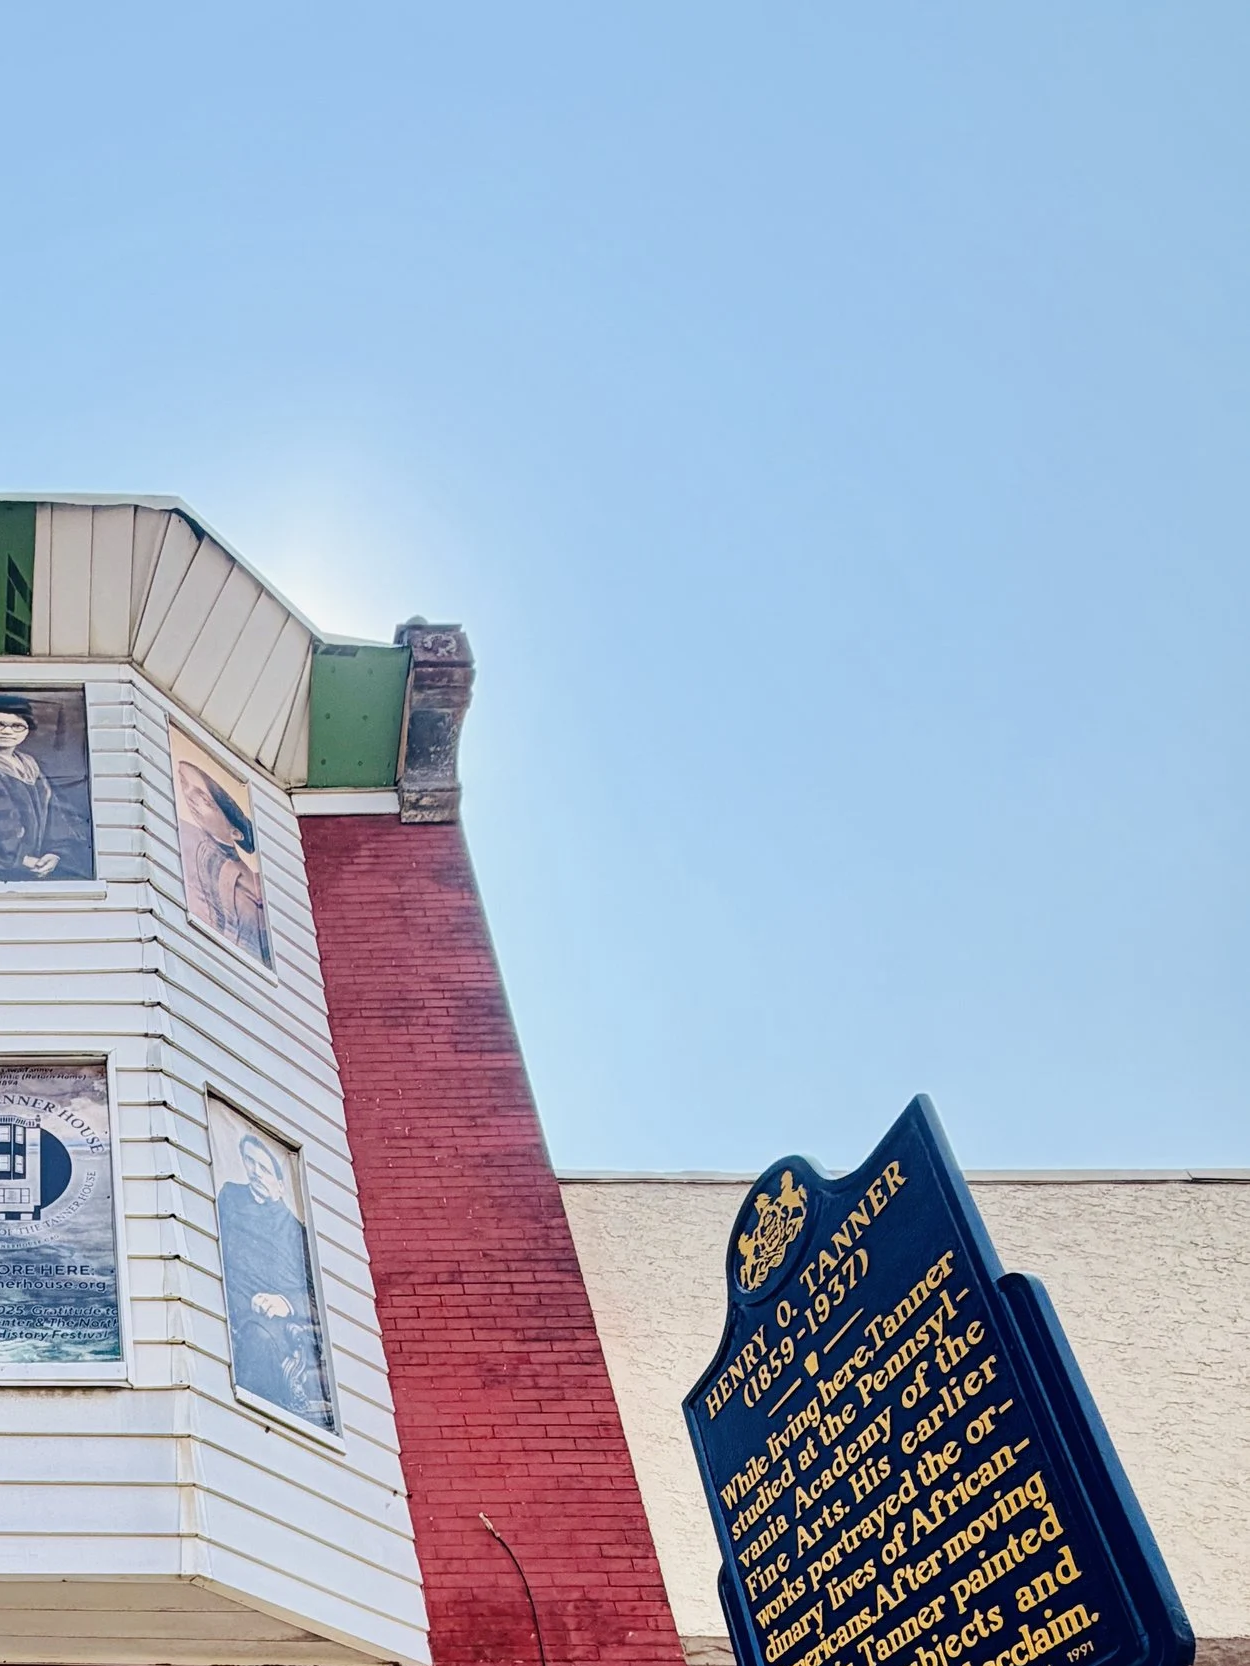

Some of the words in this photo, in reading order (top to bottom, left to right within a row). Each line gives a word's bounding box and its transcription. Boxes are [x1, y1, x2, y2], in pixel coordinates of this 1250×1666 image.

[57, 1109, 104, 1155] HOUSE
[19, 1223, 42, 1235] THE
[43, 1200, 84, 1229] TANNER
[79, 1171, 98, 1202] HOUSE
[31, 1305, 102, 1316] Gratitude
[35, 1317, 46, 1328] &
[50, 1317, 75, 1328] The
[40, 1264, 96, 1276] HERE:
[705, 1325, 768, 1420] HENRY
[776, 1300, 798, 1328] O.
[800, 1160, 908, 1297] TANNER
[52, 1330, 111, 1340] Festival
[720, 1455, 769, 1511] While
[766, 1396, 821, 1463] living
[864, 1250, 956, 1352] Tanner
[730, 1459, 796, 1542] studied
[797, 1436, 819, 1472] at
[819, 1400, 857, 1447] the
[854, 1287, 970, 1408] Pennsyl-
[738, 1511, 789, 1569] vania
[794, 1405, 893, 1519] Academy
[901, 1361, 929, 1409] of
[934, 1319, 986, 1373] the
[745, 1551, 790, 1602] Fine
[796, 1498, 851, 1559] Arts.
[847, 1454, 892, 1504] His
[900, 1354, 997, 1455] earlier
[755, 1572, 806, 1630] works
[807, 1470, 919, 1592] portrayed
[917, 1439, 962, 1487] the
[966, 1398, 1014, 1445] or-
[765, 1600, 824, 1663] dinary
[826, 1558, 877, 1611] lives
[881, 1522, 906, 1565] of
[910, 1438, 1031, 1546] African-
[875, 1549, 943, 1620] After
[942, 1470, 1049, 1564] moving
[950, 1502, 1065, 1615] painted
[1015, 1544, 1082, 1613] and
[1066, 1639, 1096, 1664] 1991
